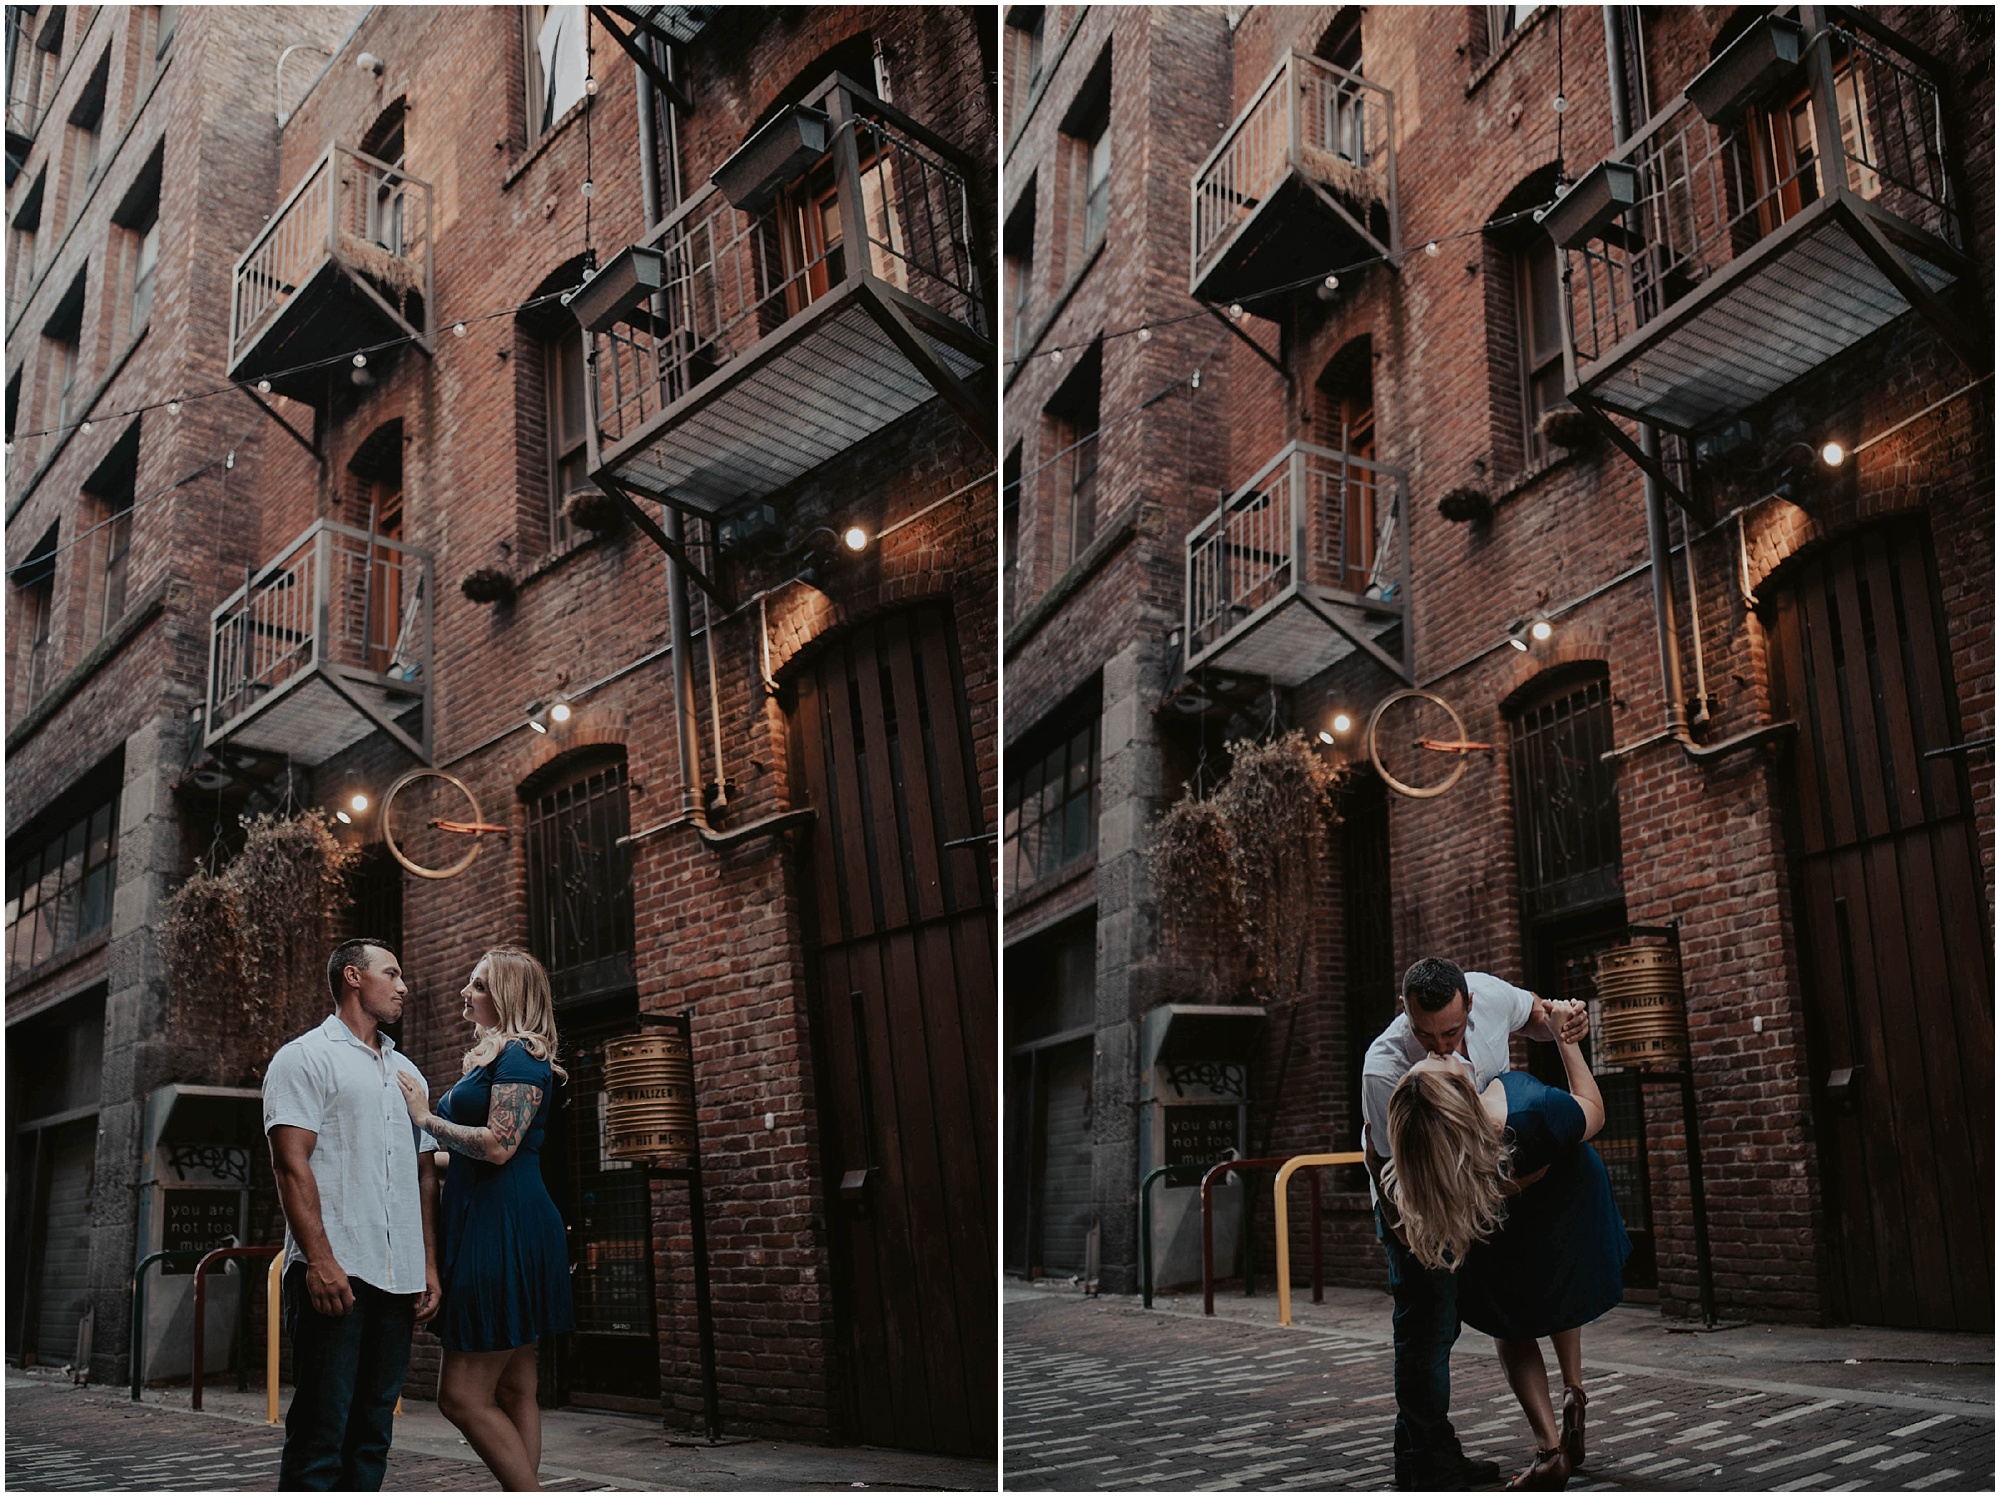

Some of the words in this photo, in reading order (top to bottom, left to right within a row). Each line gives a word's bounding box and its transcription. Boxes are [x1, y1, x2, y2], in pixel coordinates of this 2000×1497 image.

[1630, 1041, 1646, 1052] HIT
[1652, 1040, 1666, 1051] ME
[1171, 1120, 1200, 1134] you
[1207, 1119, 1233, 1131] are
[636, 1135, 652, 1146] HIT
[659, 1134, 674, 1145] ME
[1172, 1136, 1198, 1148] not
[1207, 1135, 1233, 1146] too
[1181, 1151, 1224, 1164] much
[170, 1205, 200, 1218] you
[208, 1205, 235, 1216] are
[171, 1221, 199, 1233] not
[207, 1221, 233, 1233] too
[179, 1239, 224, 1251] much
